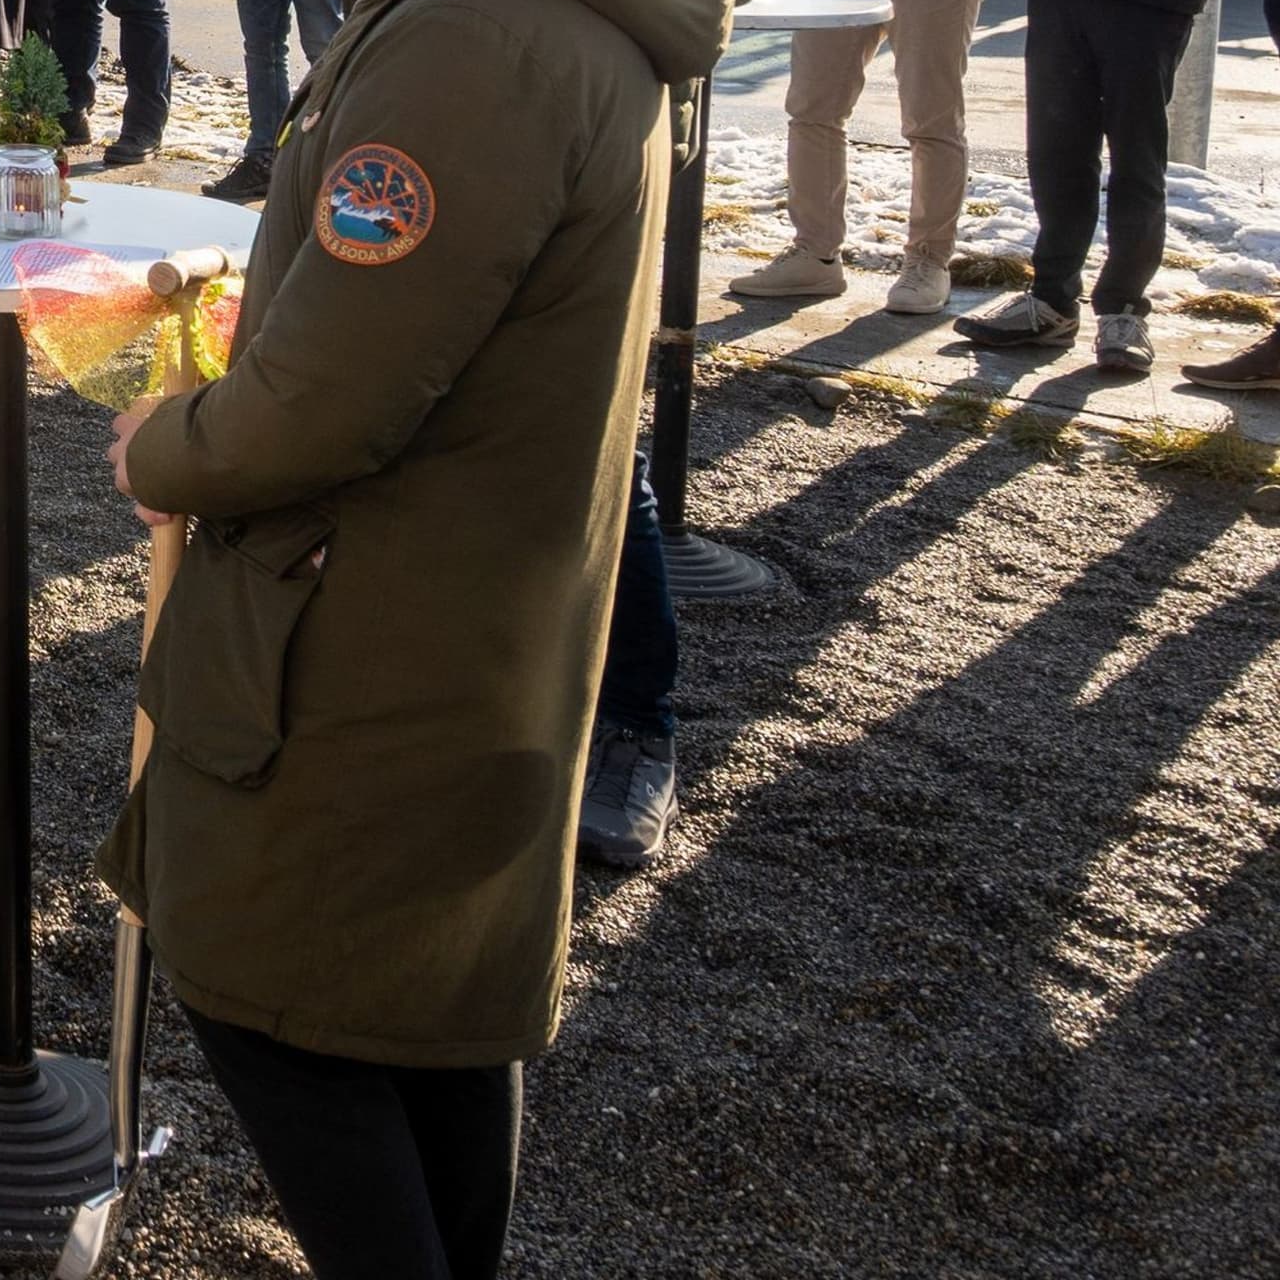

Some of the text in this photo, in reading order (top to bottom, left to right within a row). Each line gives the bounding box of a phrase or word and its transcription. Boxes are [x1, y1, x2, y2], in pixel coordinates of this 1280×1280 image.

[319, 196, 333, 241] SCOTCH
[339, 244, 379, 261] SODA
[386, 235, 414, 258] AMS
